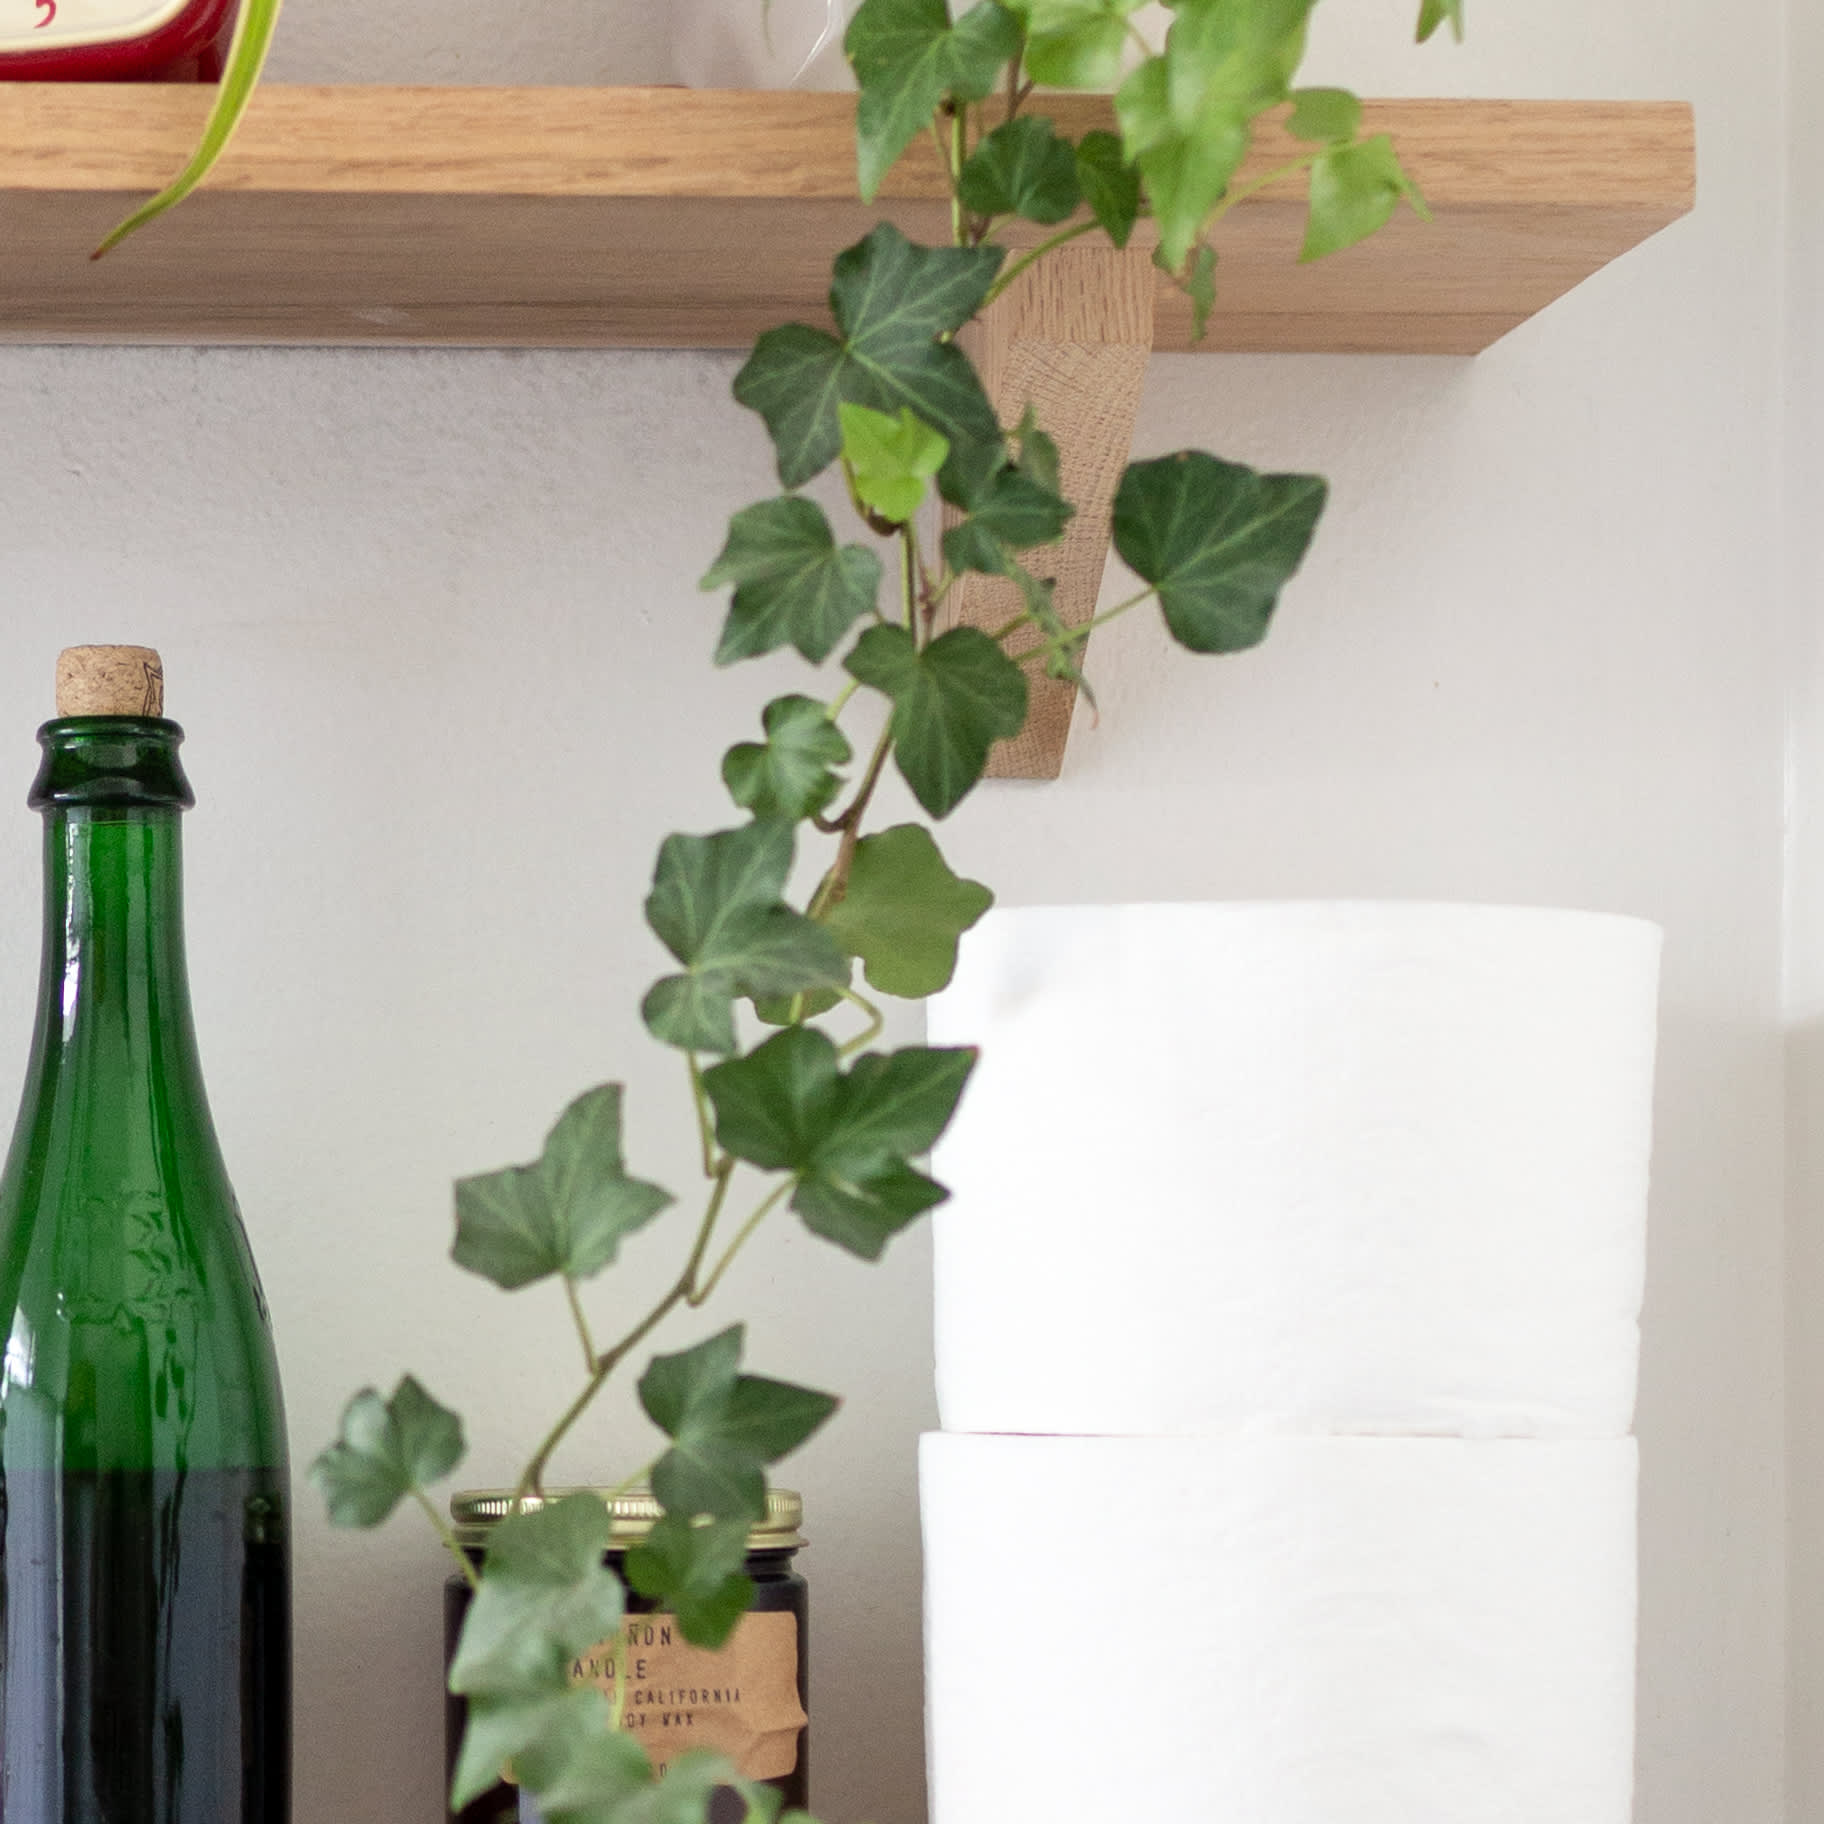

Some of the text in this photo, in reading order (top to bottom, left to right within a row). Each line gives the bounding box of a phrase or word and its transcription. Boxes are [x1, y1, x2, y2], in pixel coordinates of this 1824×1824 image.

[572, 1657, 647, 1679] ANDE
[634, 1687, 742, 1705] CALIFORNIA
[625, 1711, 695, 1728] OY WAX
